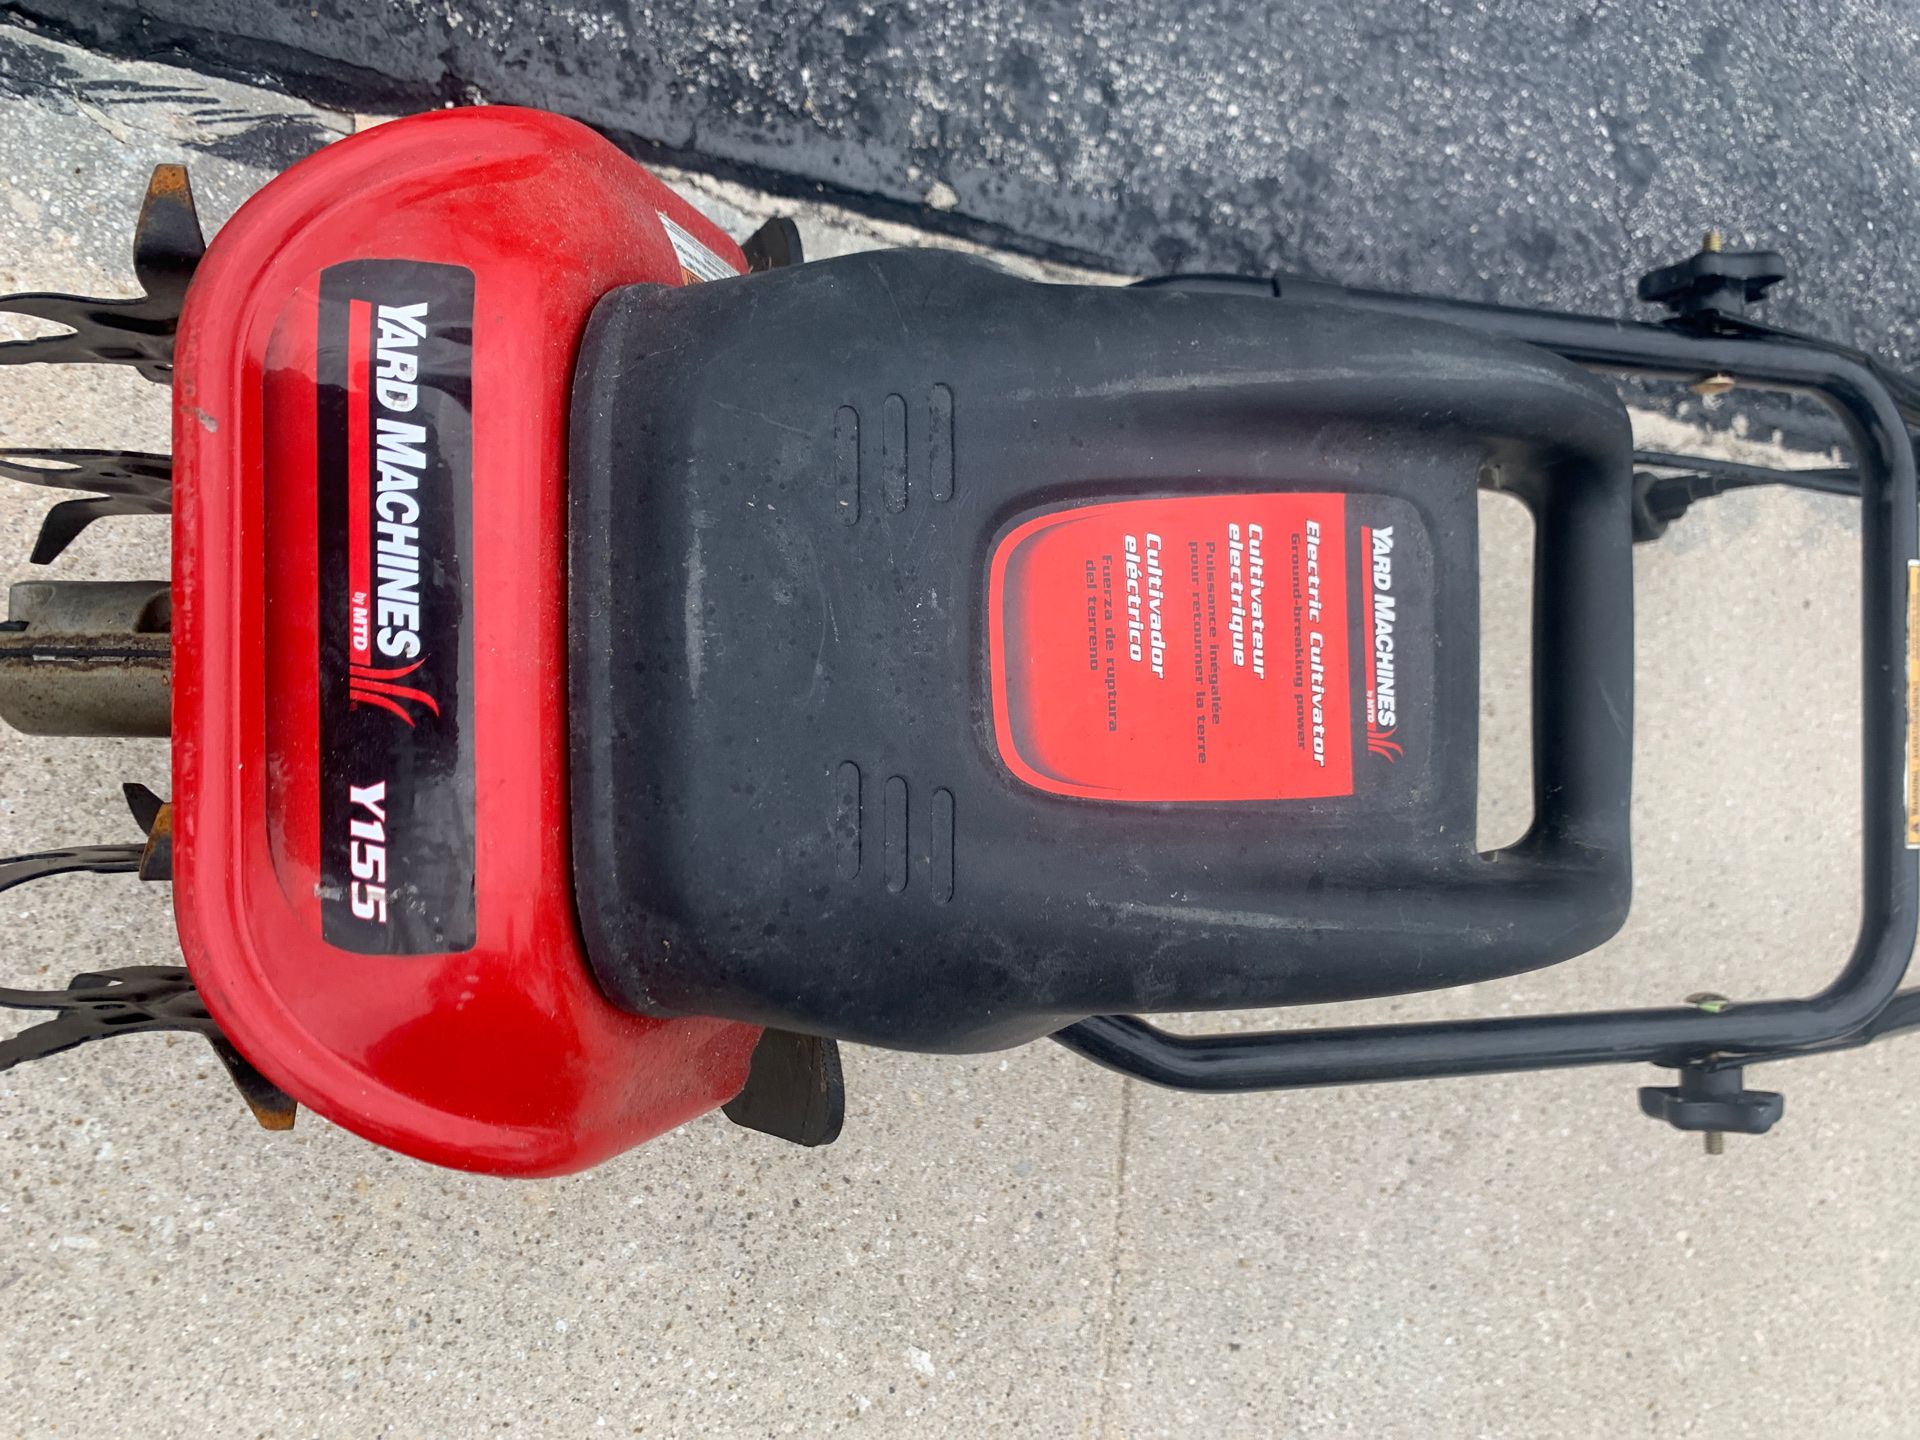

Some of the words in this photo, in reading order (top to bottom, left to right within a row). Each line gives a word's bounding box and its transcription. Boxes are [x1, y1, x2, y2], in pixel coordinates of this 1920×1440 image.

[376, 302, 428, 413] YARD
[376, 418, 427, 660] MACHINES
[1085, 559, 1098, 589] del
[1188, 541, 1199, 585] pour
[1306, 519, 1323, 623] Electric
[1372, 525, 1394, 591] YARD
[352, 591, 367, 605] by
[1103, 555, 1113, 620] Fuerza
[1124, 534, 1145, 662] eléctrico
[1146, 532, 1166, 679] Cultivador
[1205, 541, 1217, 638] Puissance
[1248, 522, 1265, 680] Cultivateur
[1291, 533, 1305, 688] Ground-breaking
[352, 606, 368, 651] MTD
[1087, 595, 1099, 671] terreno
[1105, 627, 1116, 651] de
[1192, 592, 1203, 685] retourner
[1374, 593, 1396, 727] MACHINES
[1105, 658, 1117, 732] ruptura
[1195, 691, 1205, 709] la
[1206, 644, 1221, 725] inégalée
[1293, 693, 1305, 750] power
[1309, 630, 1325, 767] Cultivator
[1366, 698, 1374, 723] MTD
[1196, 714, 1206, 764] terre
[350, 780, 387, 923] Y155
